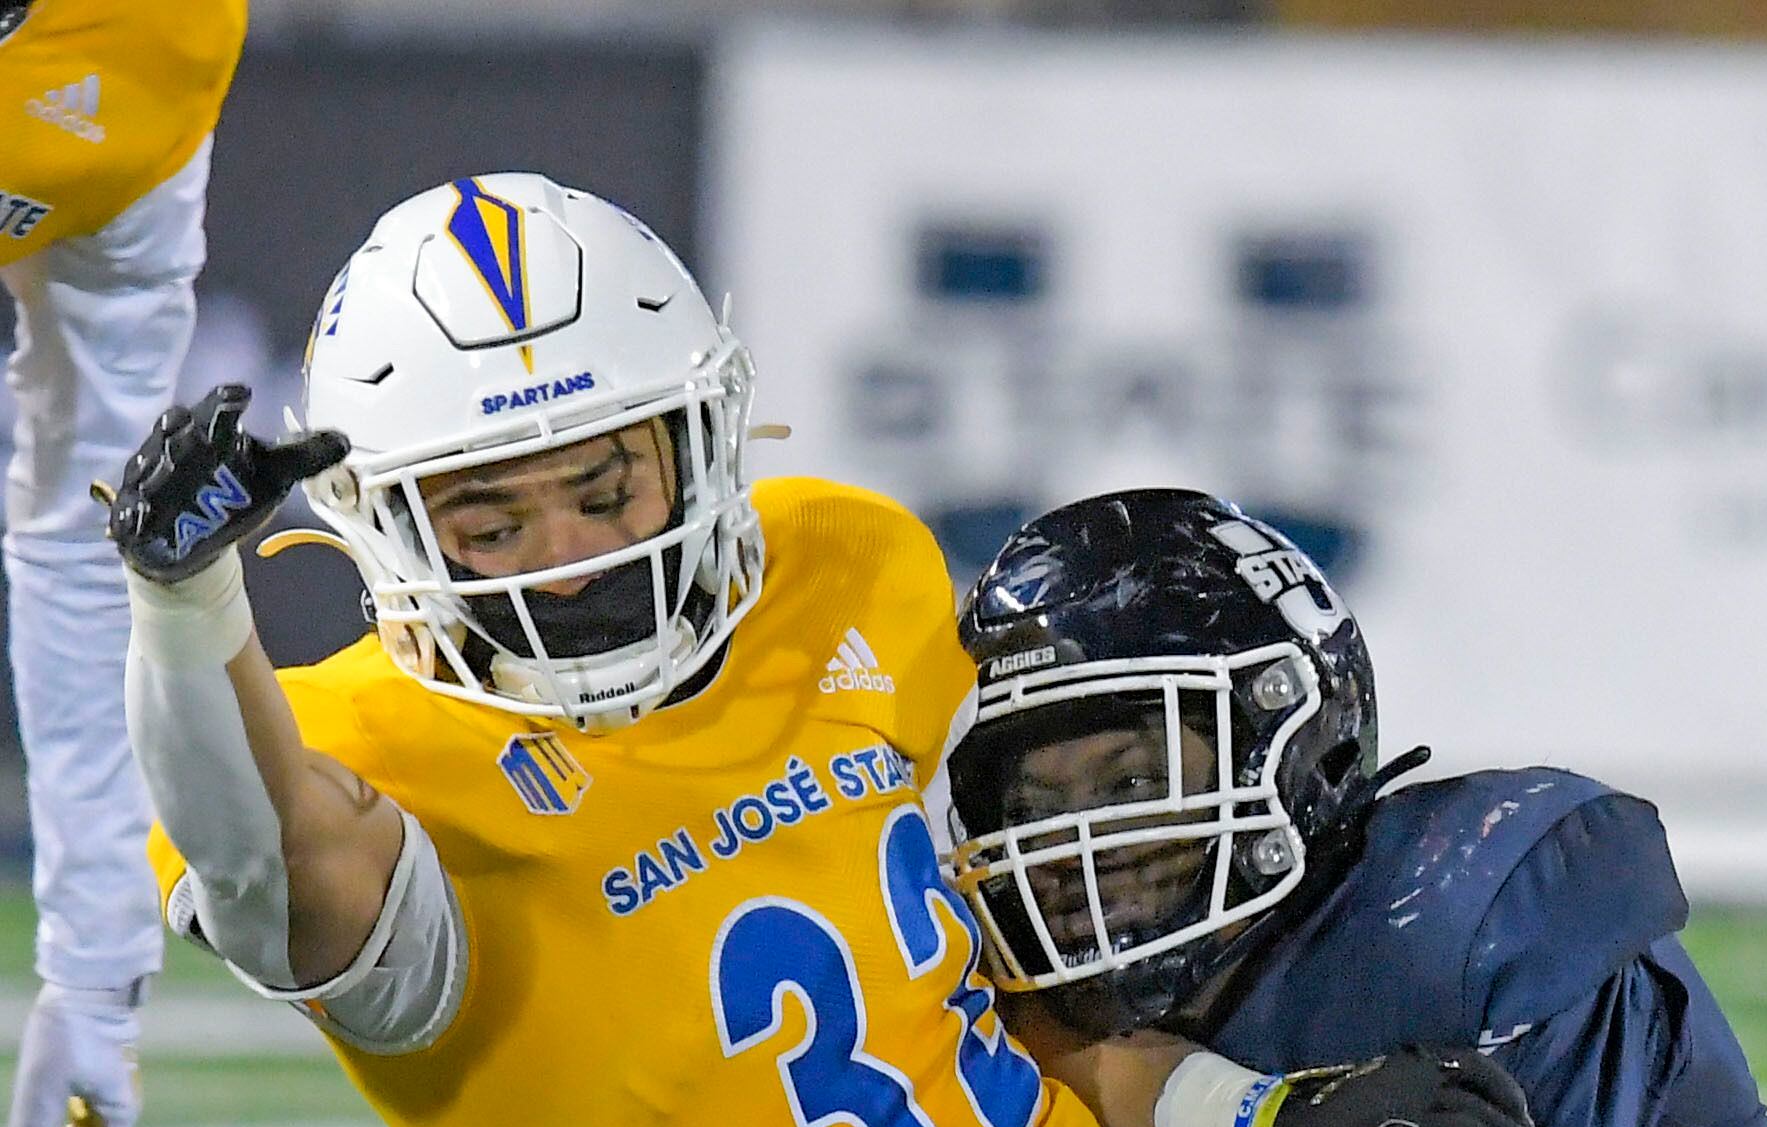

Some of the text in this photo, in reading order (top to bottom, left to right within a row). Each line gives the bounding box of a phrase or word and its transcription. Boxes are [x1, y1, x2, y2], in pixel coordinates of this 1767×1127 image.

[0, 190, 51, 237] TE
[481, 371, 595, 415] SPARTANS
[1235, 549, 1318, 604] STA
[818, 667, 896, 694] adidas
[989, 645, 1056, 679] AGGIES
[579, 681, 635, 704] Riddell
[603, 745, 916, 917] SAN JOSÉ STA
